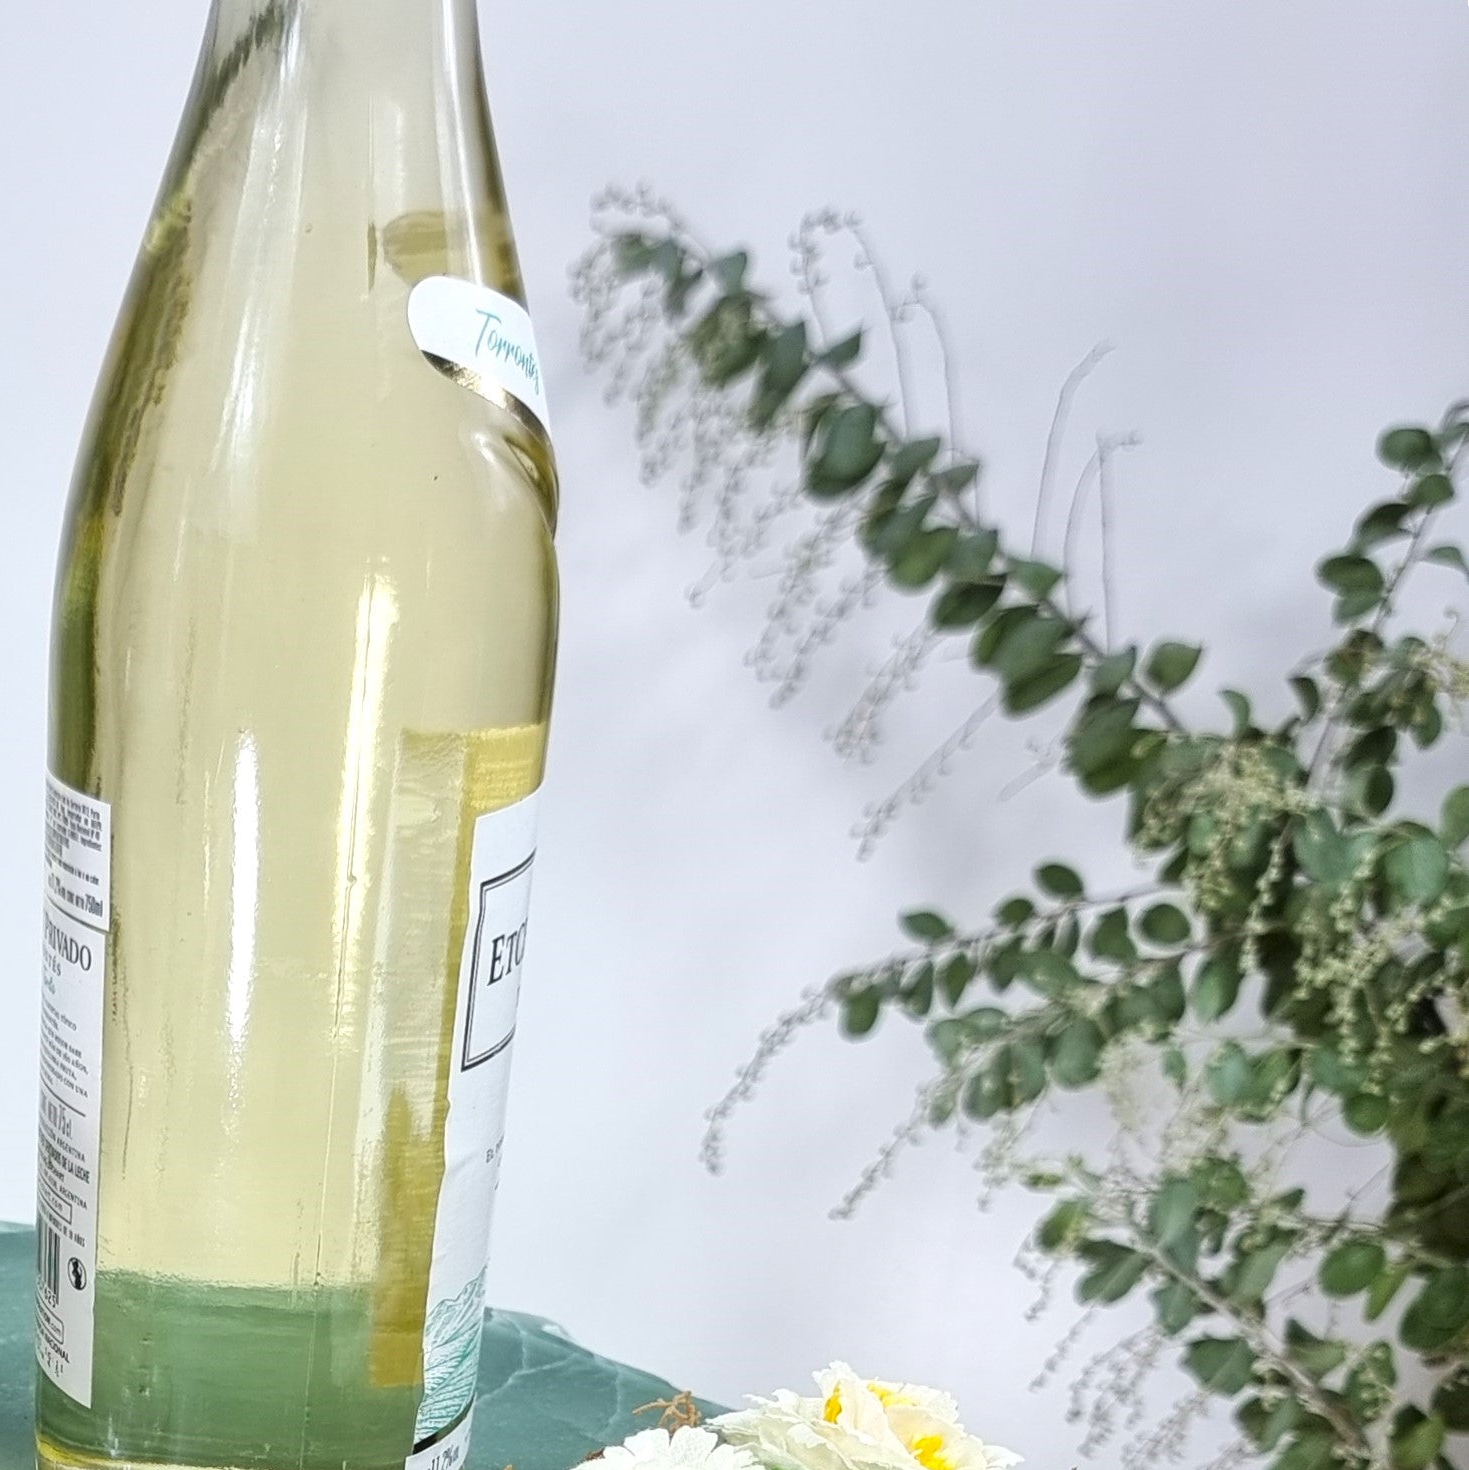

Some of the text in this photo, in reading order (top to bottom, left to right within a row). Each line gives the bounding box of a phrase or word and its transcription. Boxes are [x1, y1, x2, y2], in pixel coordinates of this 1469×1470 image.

[44, 911, 92, 971] PRIVADO
[74, 1164, 90, 1184] LECHE
[60, 1184, 87, 1209] ARGENTINA
